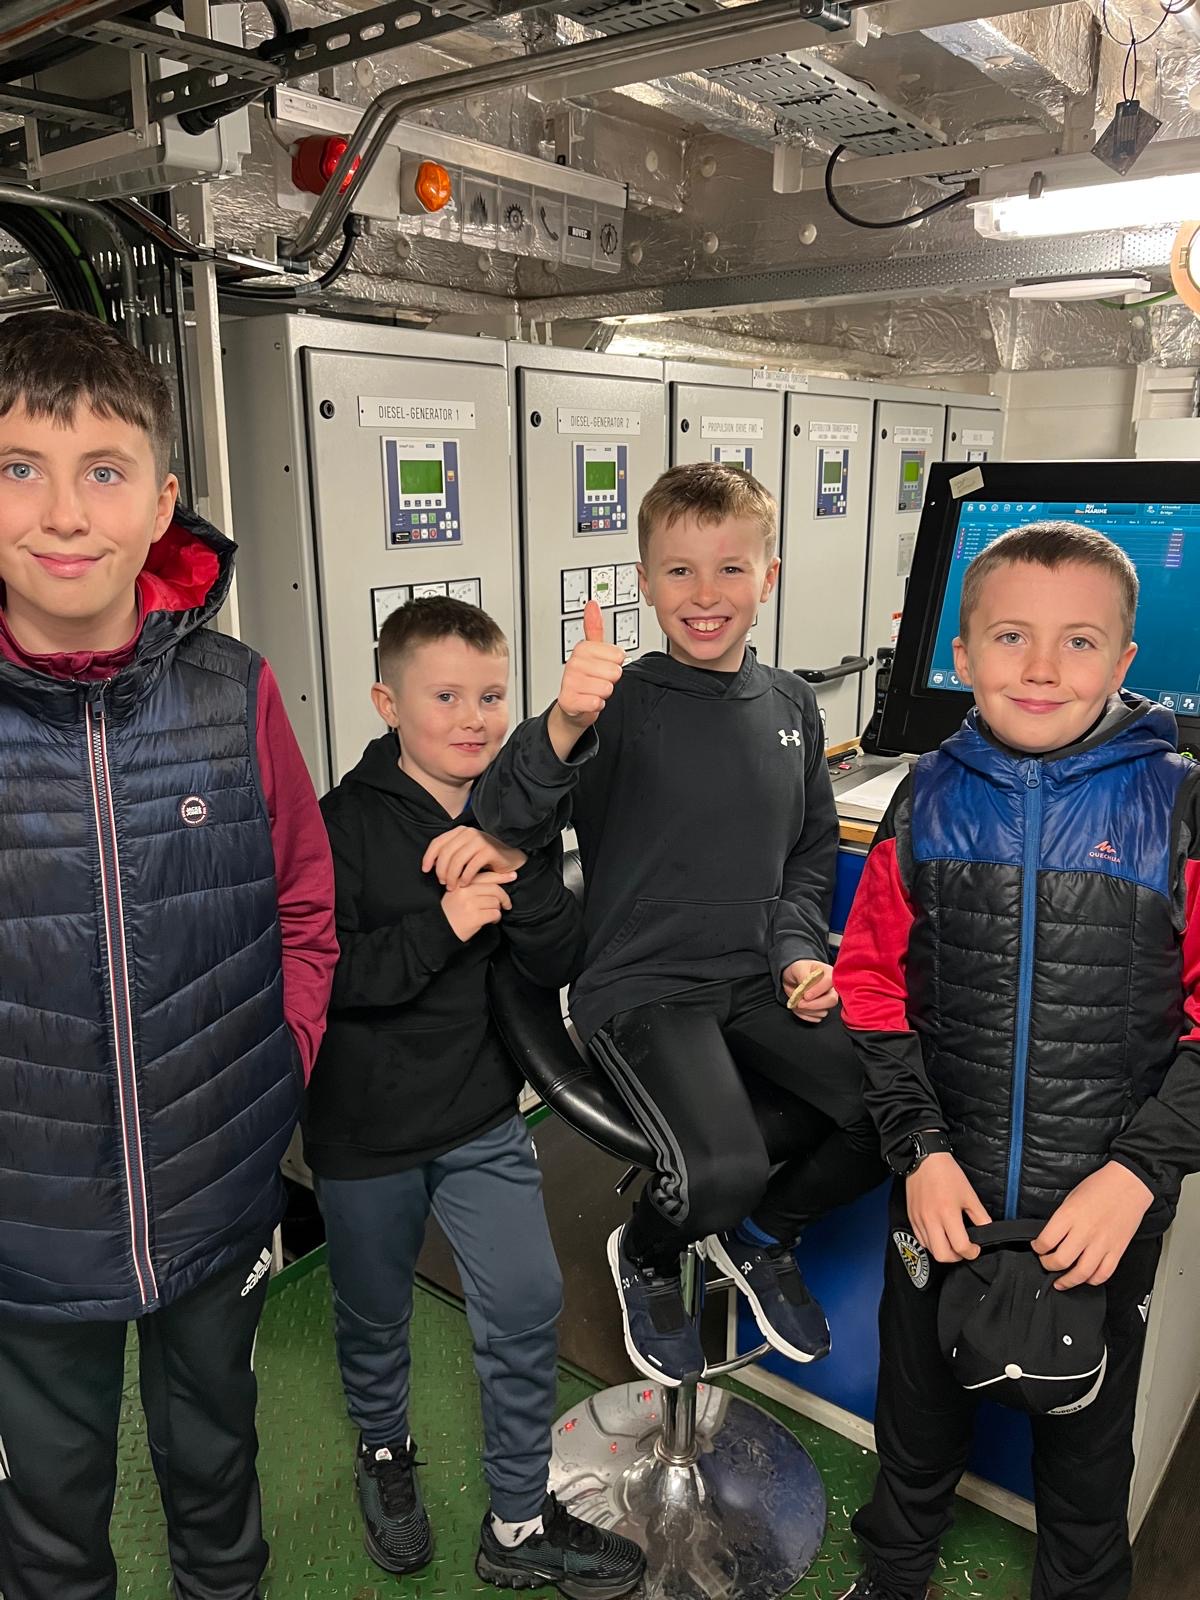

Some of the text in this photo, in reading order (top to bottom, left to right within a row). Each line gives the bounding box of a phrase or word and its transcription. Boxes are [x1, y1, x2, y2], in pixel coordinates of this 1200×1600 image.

[378, 405, 460, 421] DIESEL-GENERATOR 1
[570, 415, 630, 428] DIESEL-GENERATOR 2
[708, 422, 734, 432] PROPULSION
[735, 423, 748, 432] DRIVE
[1089, 851, 1120, 863] QUECHUA
